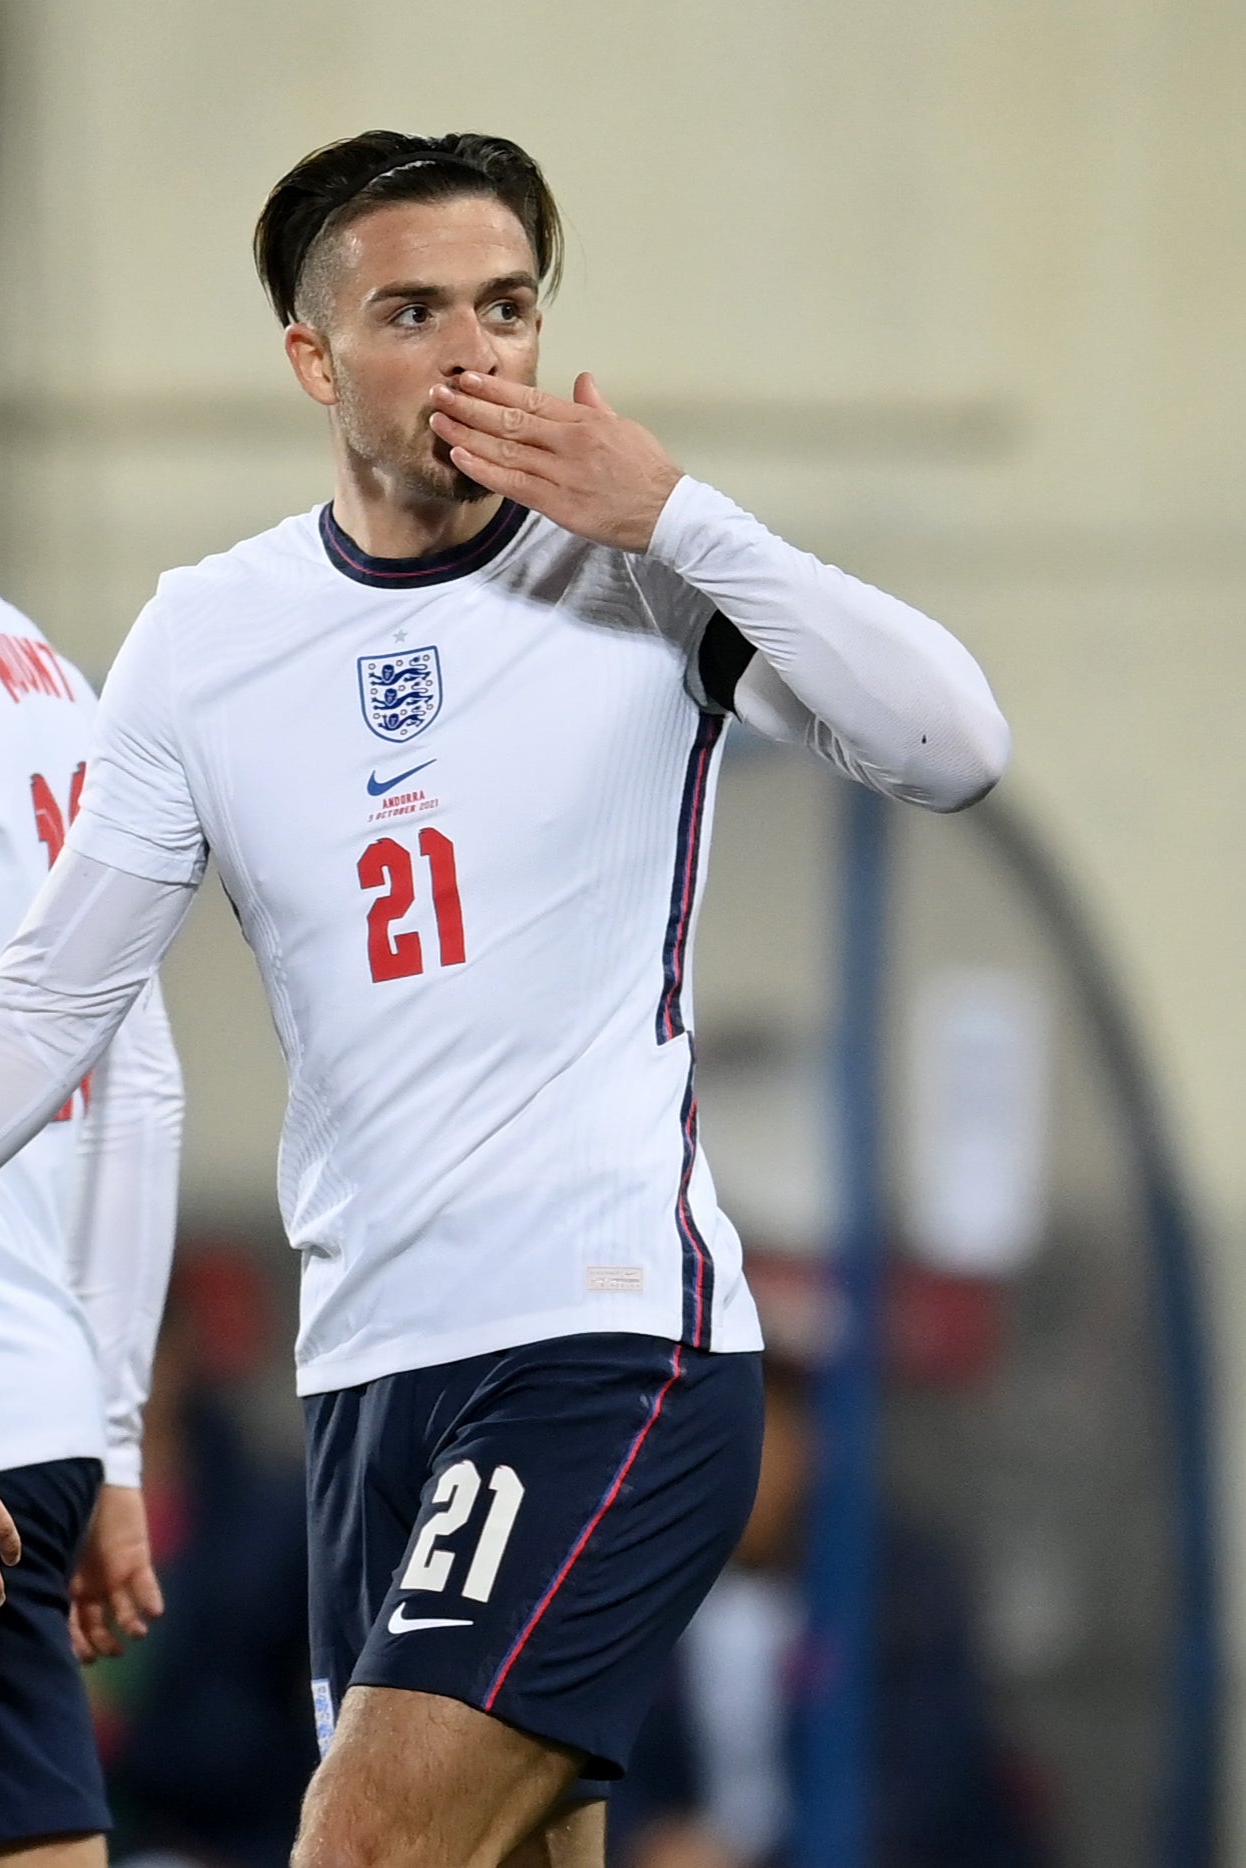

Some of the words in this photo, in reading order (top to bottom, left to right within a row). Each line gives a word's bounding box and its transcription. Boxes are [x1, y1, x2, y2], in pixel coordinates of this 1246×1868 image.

[375, 804, 416, 821] OCTOBER
[418, 798, 439, 811] 2021
[382, 789, 426, 809] ANDORRA
[356, 826, 466, 984] 21
[399, 1458, 525, 1603] 21
